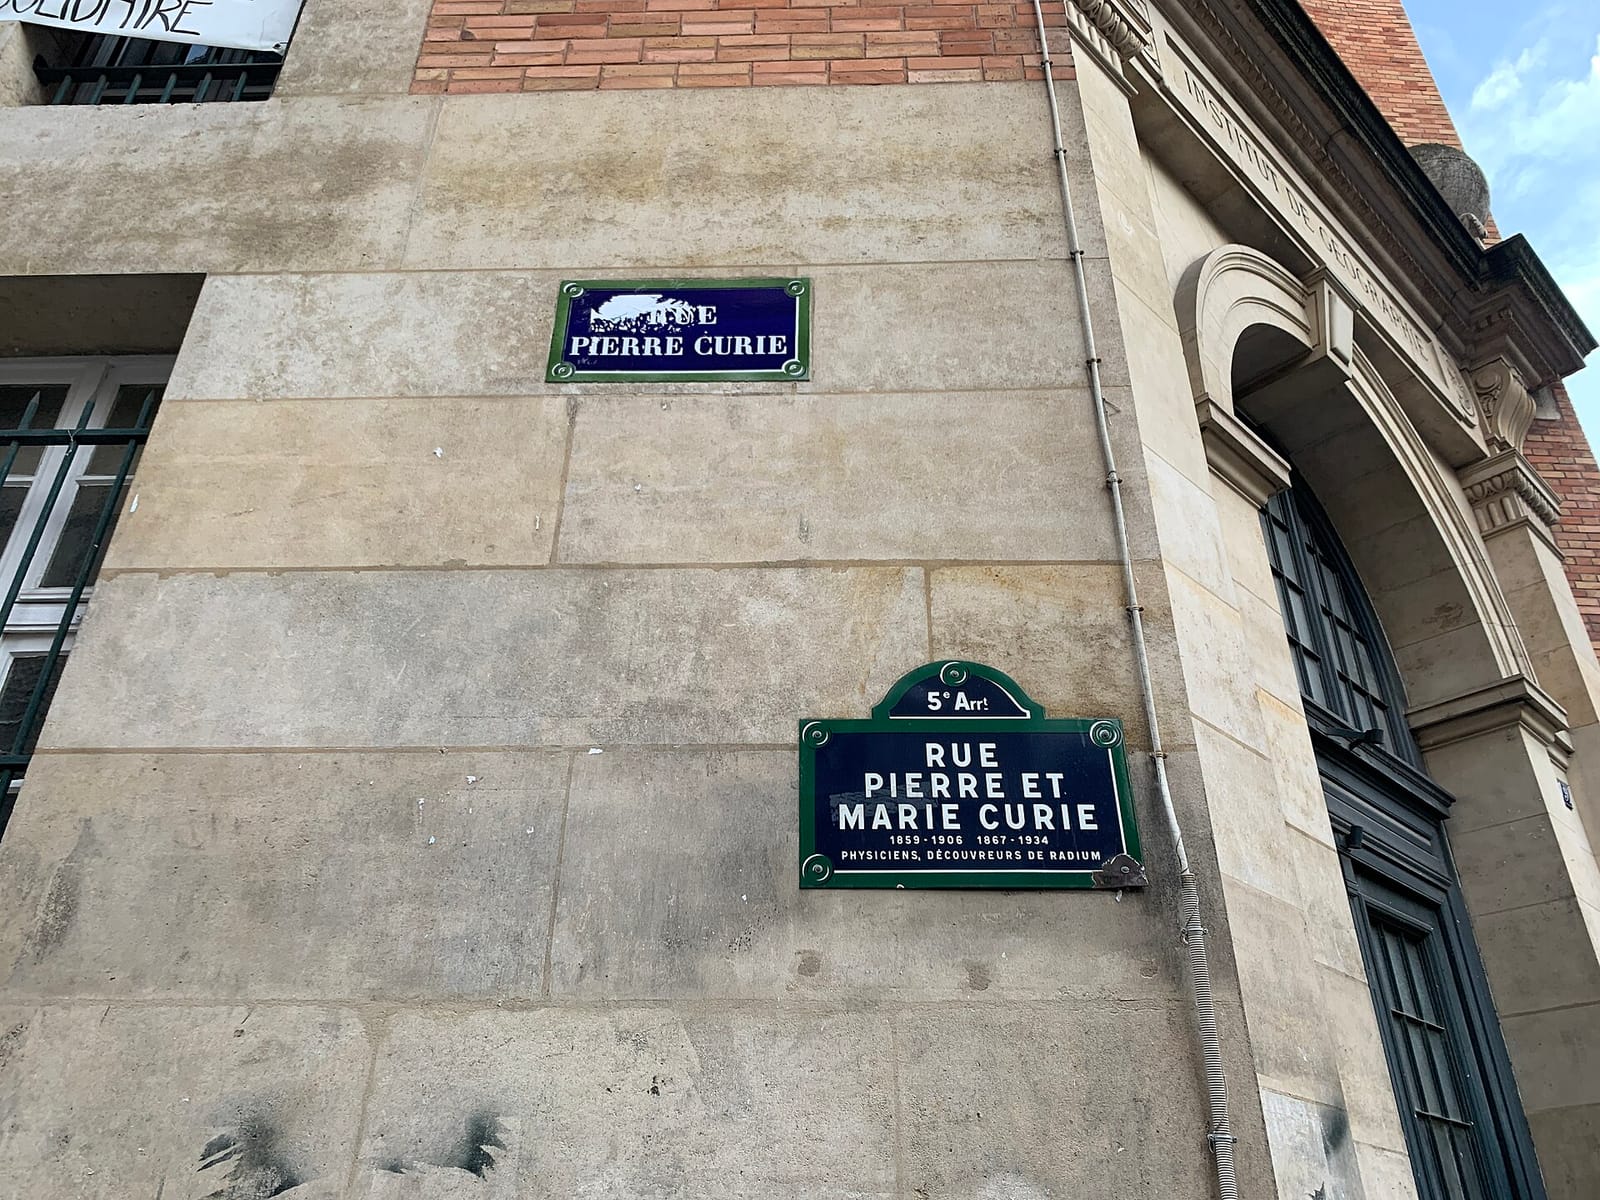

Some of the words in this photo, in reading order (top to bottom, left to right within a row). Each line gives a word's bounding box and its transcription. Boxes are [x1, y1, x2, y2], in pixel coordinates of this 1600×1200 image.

[0, 0, 213, 36] LIDAIRE
[1184, 69, 1279, 193] INSTITUT
[1285, 186, 1315, 233] DE
[569, 336, 684, 356] PIERRE
[694, 335, 788, 356] CURIE
[926, 742, 999, 768] RUE
[864, 772, 1006, 799] PIERRE
[1021, 772, 1064, 799] ET
[838, 803, 961, 830] MARIE
[978, 803, 1099, 831] CURIE
[841, 850, 921, 861] PHYSICIENS,
[927, 848, 1022, 861] DÉCOUVREURS
[1028, 850, 1045, 861] DE
[1050, 850, 1101, 861] RADIUM
